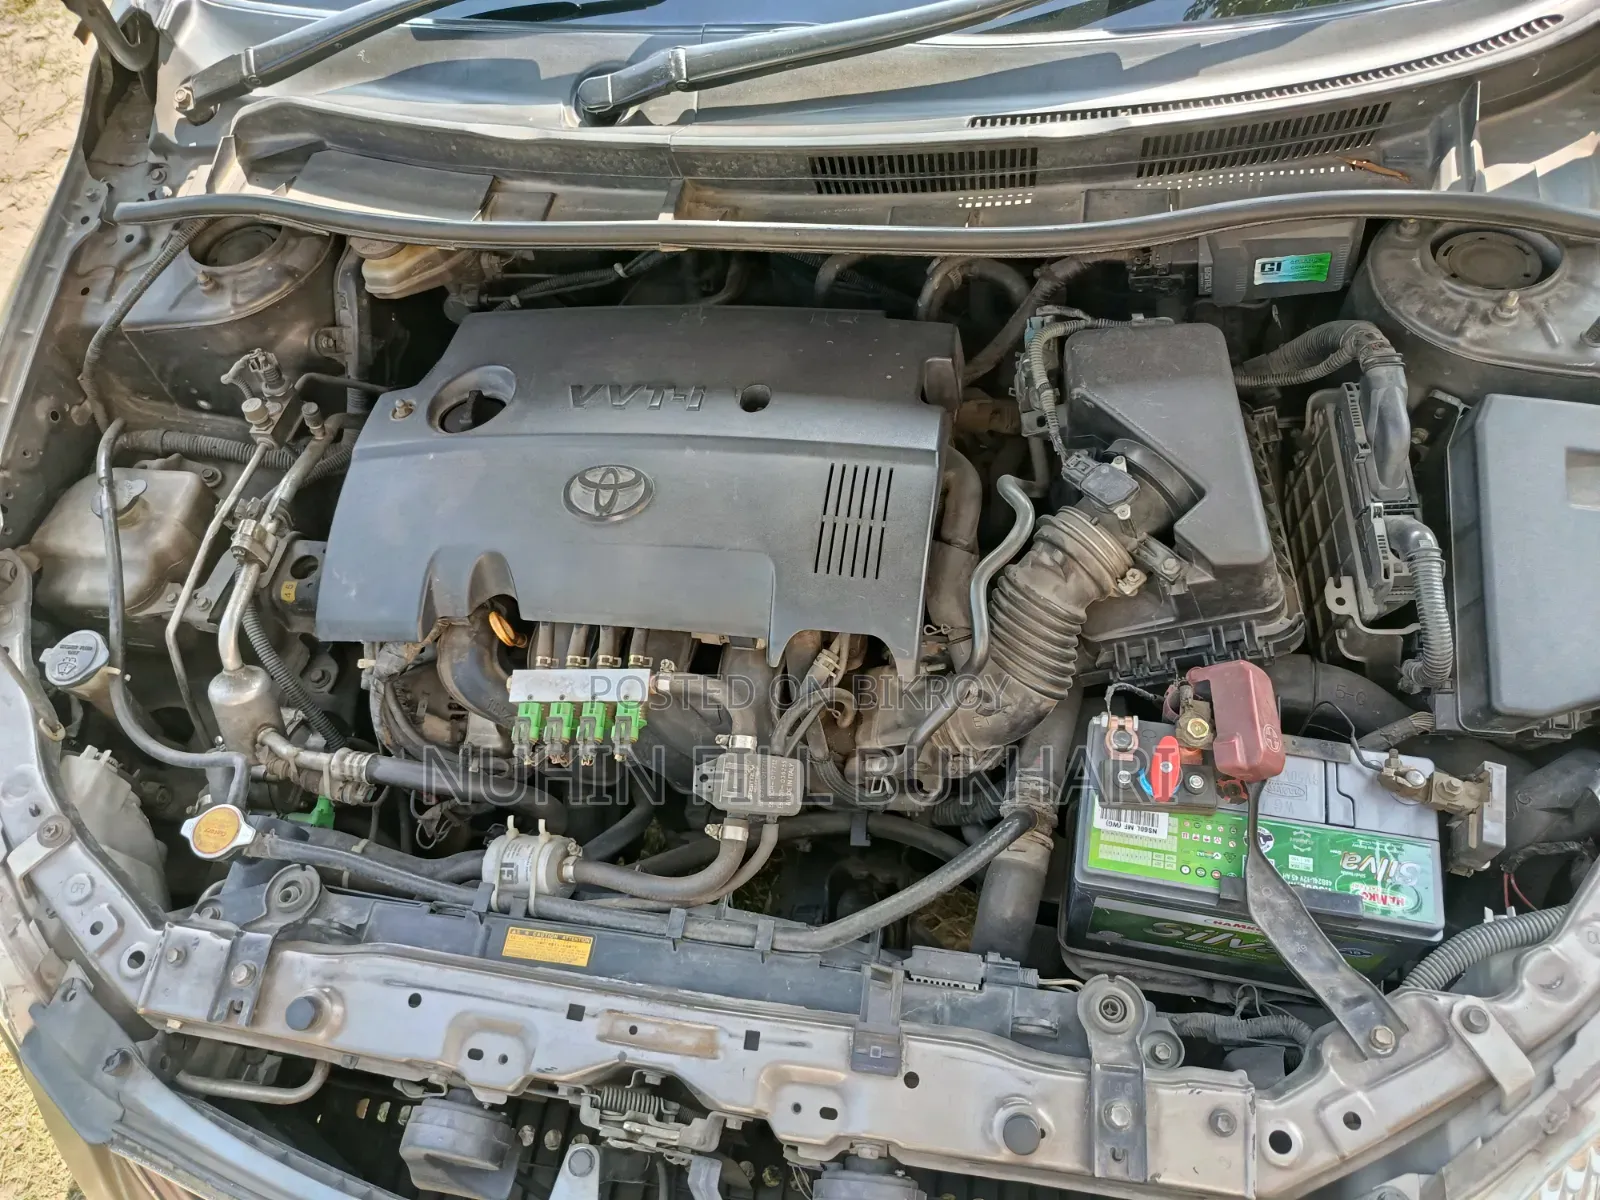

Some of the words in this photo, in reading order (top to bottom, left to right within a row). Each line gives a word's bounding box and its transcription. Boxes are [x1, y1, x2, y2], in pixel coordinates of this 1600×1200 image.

[1340, 851, 1421, 886] Silva
[532, 931, 559, 940] CAUTION
[563, 935, 591, 944] ATTENTION
